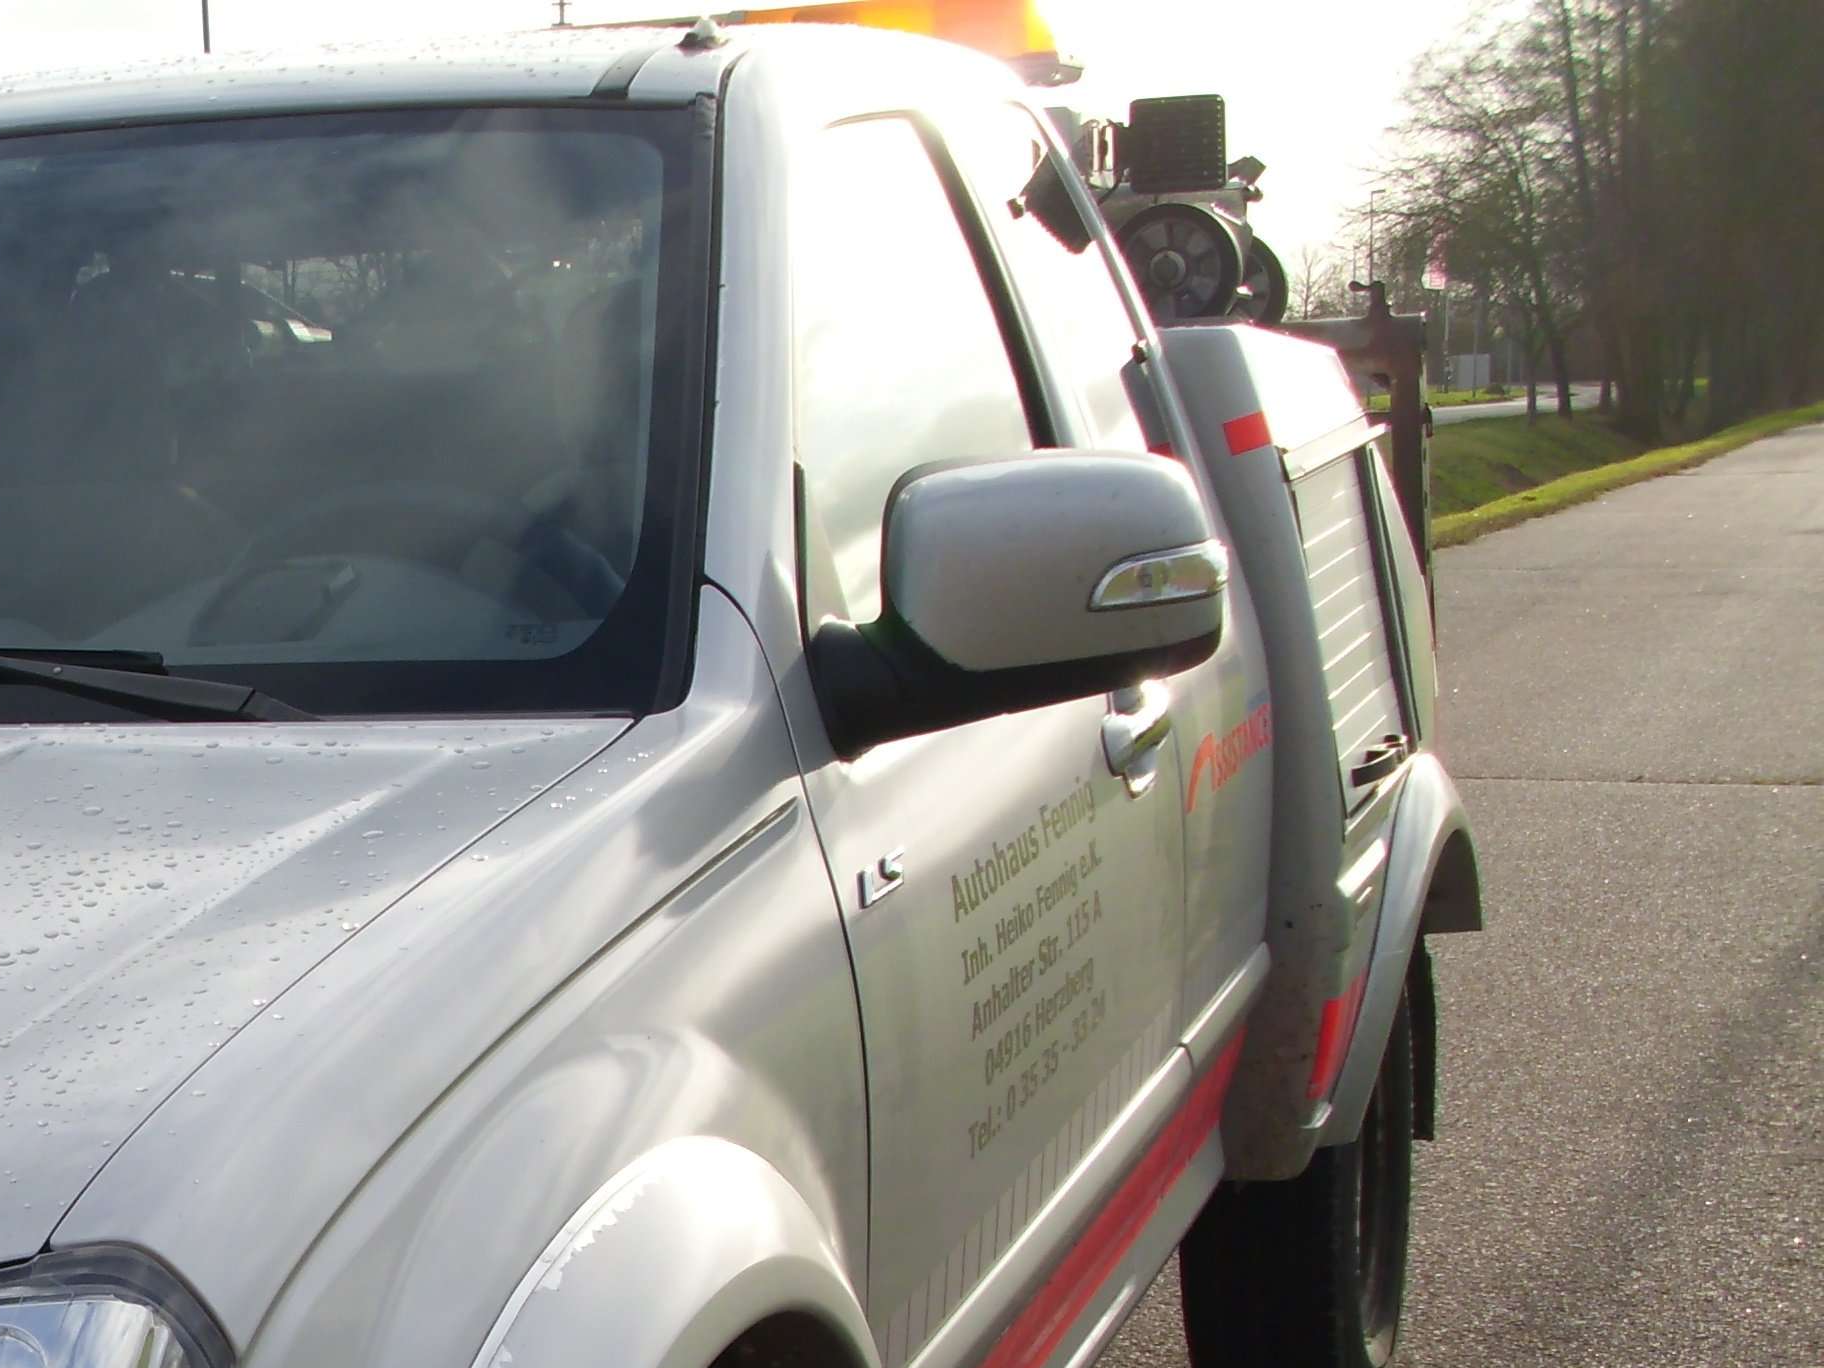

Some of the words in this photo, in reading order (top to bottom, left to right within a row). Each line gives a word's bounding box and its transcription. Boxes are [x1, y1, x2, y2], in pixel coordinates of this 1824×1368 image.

[856, 847, 905, 910] LS
[951, 825, 1039, 923] Autohaus
[1039, 776, 1095, 848] Fennig
[961, 937, 993, 986] Inh.
[995, 902, 1035, 955] Heiko
[1036, 861, 1078, 919] Fennig
[971, 958, 1035, 1040] Anhalter
[1038, 936, 1063, 976] Str.
[1066, 900, 1090, 950] 115
[1093, 890, 1102, 924] A
[985, 1012, 1032, 1086] 04916
[1034, 957, 1094, 1037] Herzberg
[968, 1103, 1001, 1160] Tel.:
[1007, 1085, 1016, 1121] 0
